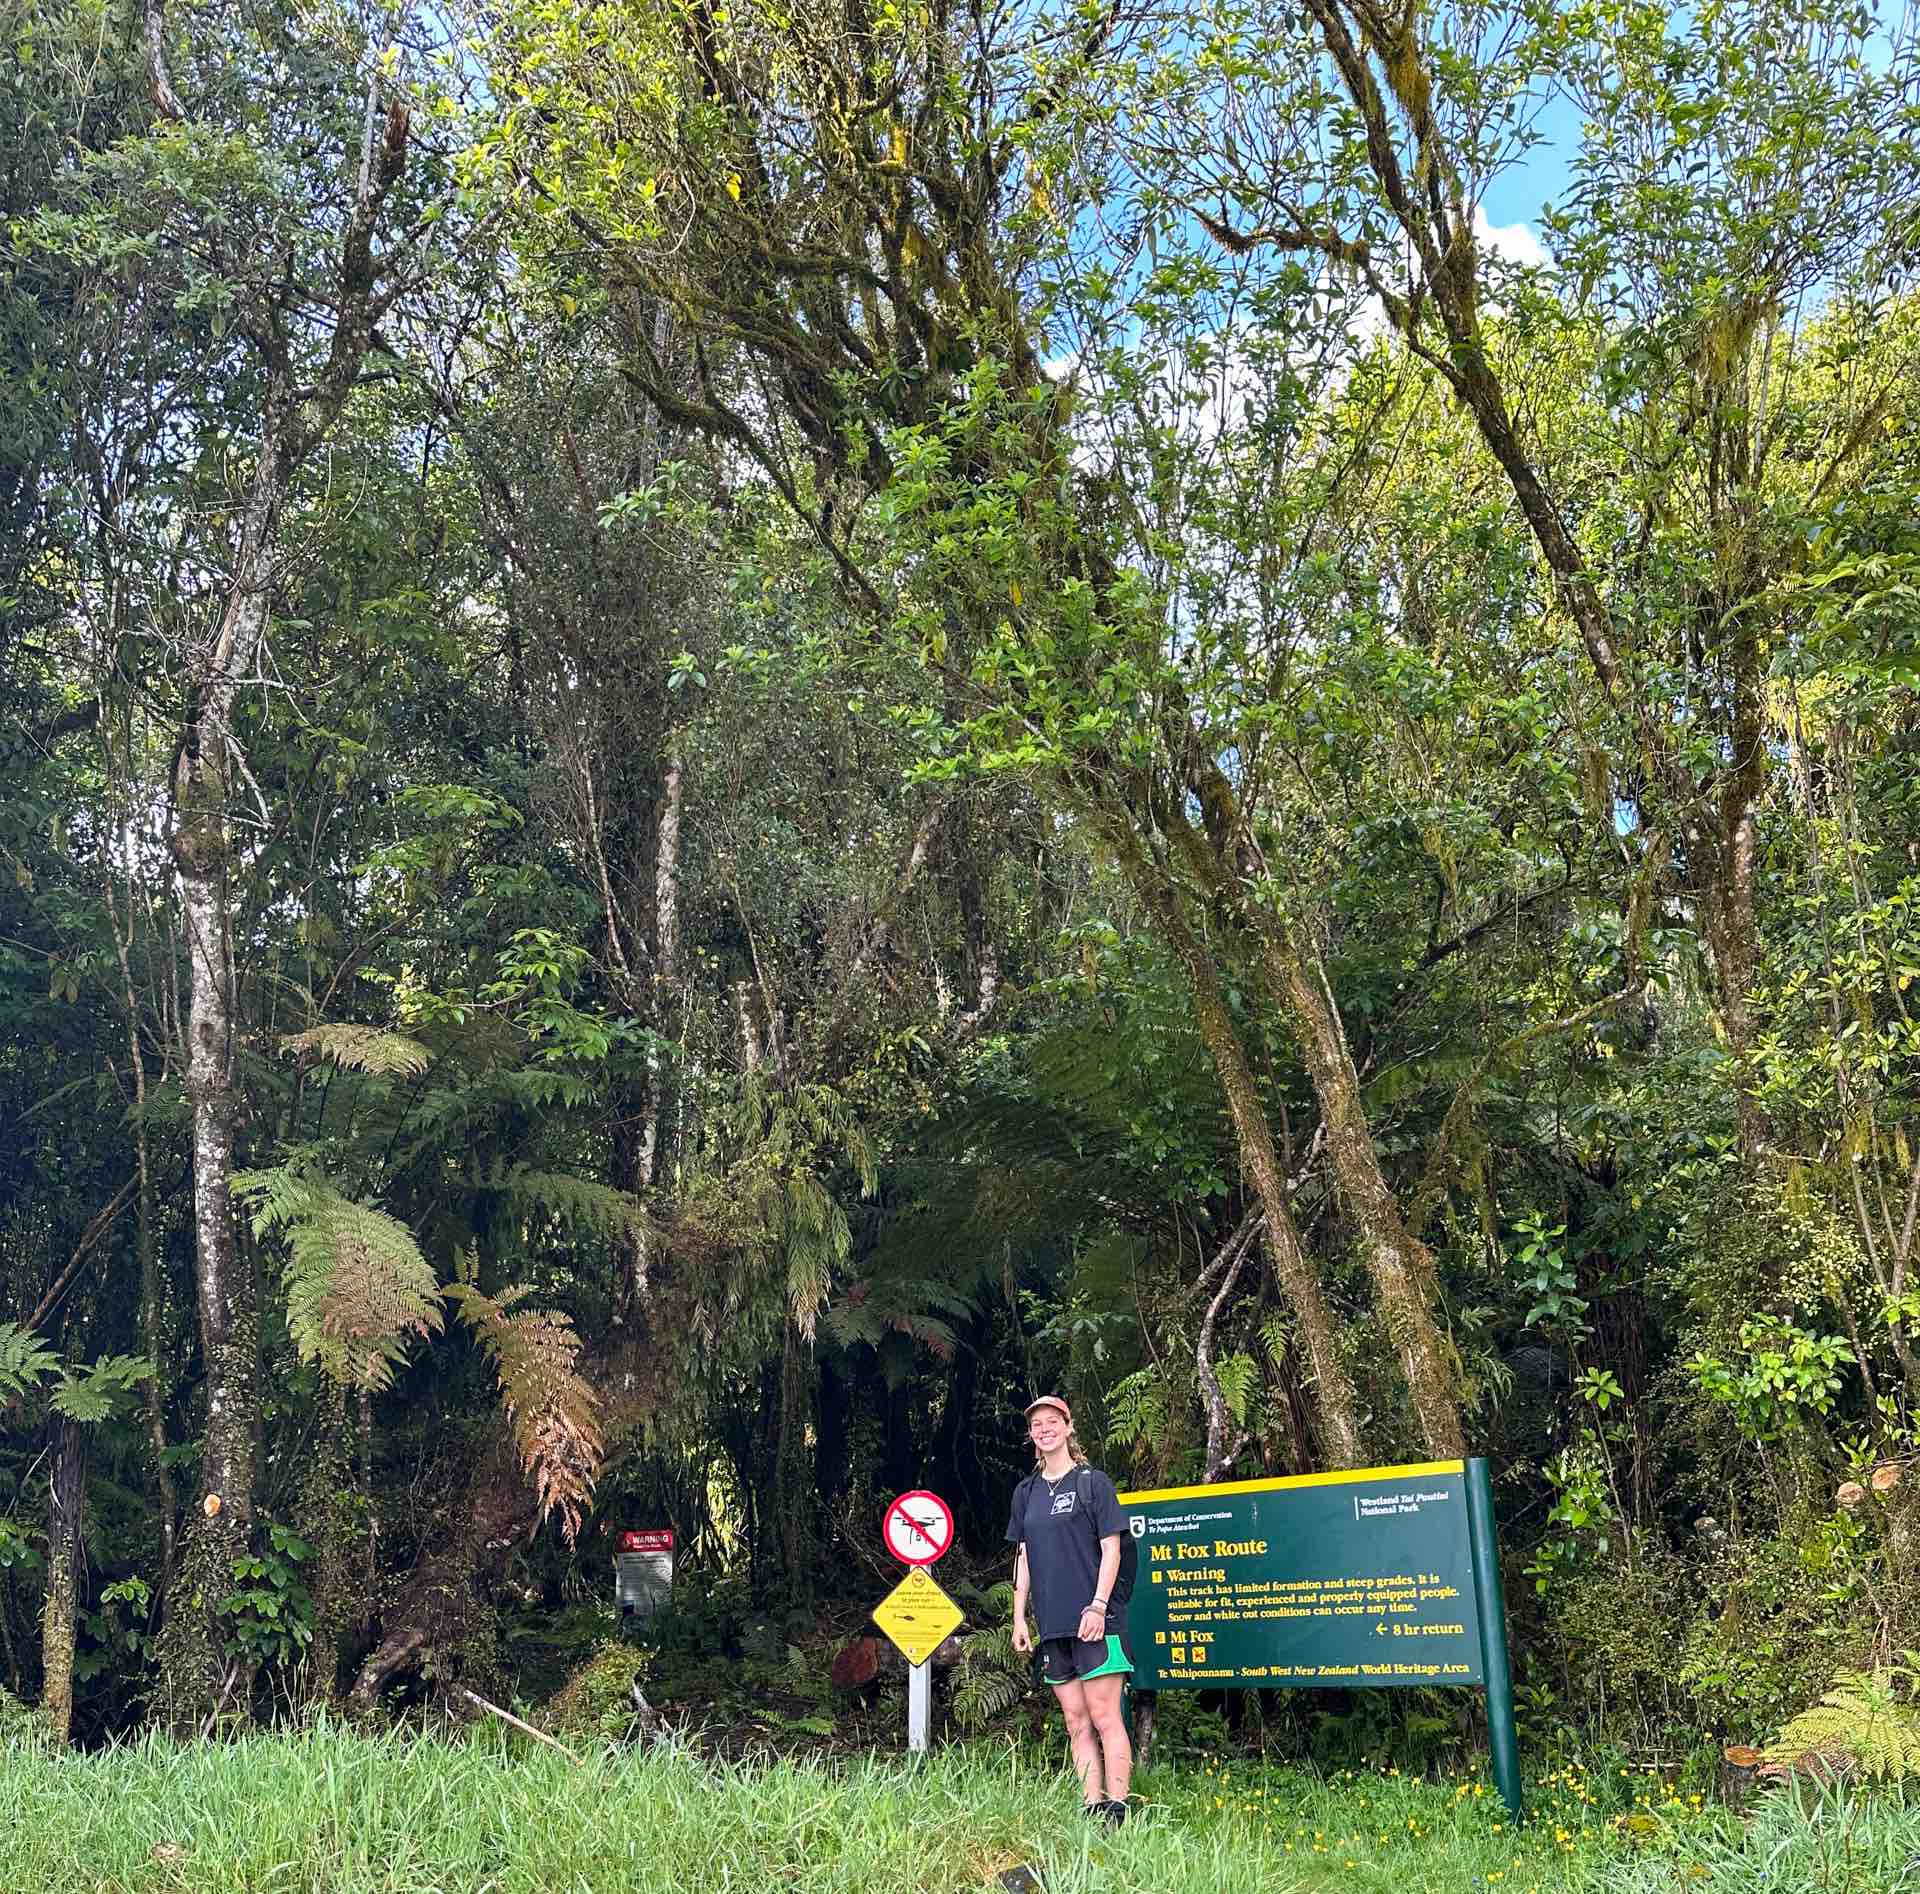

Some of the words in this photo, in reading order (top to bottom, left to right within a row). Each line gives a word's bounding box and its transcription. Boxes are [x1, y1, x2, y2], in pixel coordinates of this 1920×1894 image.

[1360, 1496, 1399, 1506] Westland
[1400, 1494, 1414, 1503] Tai
[1361, 1506, 1396, 1516] National
[1398, 1503, 1419, 1513] Park
[1148, 1515, 1183, 1525] Department
[1184, 1513, 1191, 1521] of
[1191, 1511, 1232, 1520] Conservation
[1151, 1545, 1173, 1561] Mt
[1177, 1543, 1210, 1560] Fox
[1214, 1540, 1267, 1557] Route
[1167, 1567, 1226, 1582] Warning
[1167, 1587, 1188, 1597] This
[1189, 1585, 1213, 1595] track
[1216, 1584, 1232, 1594] has
[1235, 1582, 1270, 1593] limited
[1272, 1579, 1321, 1592] formation
[1324, 1577, 1343, 1588] and
[1346, 1576, 1374, 1589] steep
[1376, 1575, 1415, 1588] grades.
[1418, 1574, 1427, 1584] It
[1429, 1573, 1440, 1583] is
[1168, 1598, 1202, 1609] suitable
[1205, 1597, 1217, 1608] for
[1220, 1596, 1234, 1608] fit,
[1236, 1593, 1295, 1608] experienced
[1298, 1592, 1316, 1603] and
[1320, 1590, 1365, 1604] properly
[1367, 1588, 1417, 1602] equipped
[1420, 1586, 1460, 1600] people.
[1168, 1612, 1192, 1622] Snow
[1194, 1610, 1212, 1621] and
[1214, 1608, 1241, 1619] white
[1242, 1609, 1258, 1618] out
[1260, 1606, 1311, 1618] conditions
[1313, 1606, 1331, 1616] can
[1334, 1605, 1363, 1614] occur
[1366, 1604, 1386, 1615] any
[1389, 1602, 1417, 1612] time.
[1393, 1624, 1401, 1636] 8
[1404, 1623, 1421, 1635] hr
[1423, 1622, 1464, 1635] return
[1170, 1631, 1187, 1644] Mt
[1189, 1630, 1215, 1643] Fox
[1158, 1669, 1168, 1679] Te
[1241, 1666, 1267, 1677] South
[1271, 1666, 1292, 1676] West
[1294, 1665, 1315, 1676] New
[1318, 1664, 1359, 1676] Zealand
[1361, 1663, 1391, 1675] World
[1394, 1663, 1440, 1676] Heritage
[1443, 1663, 1469, 1673] Area
